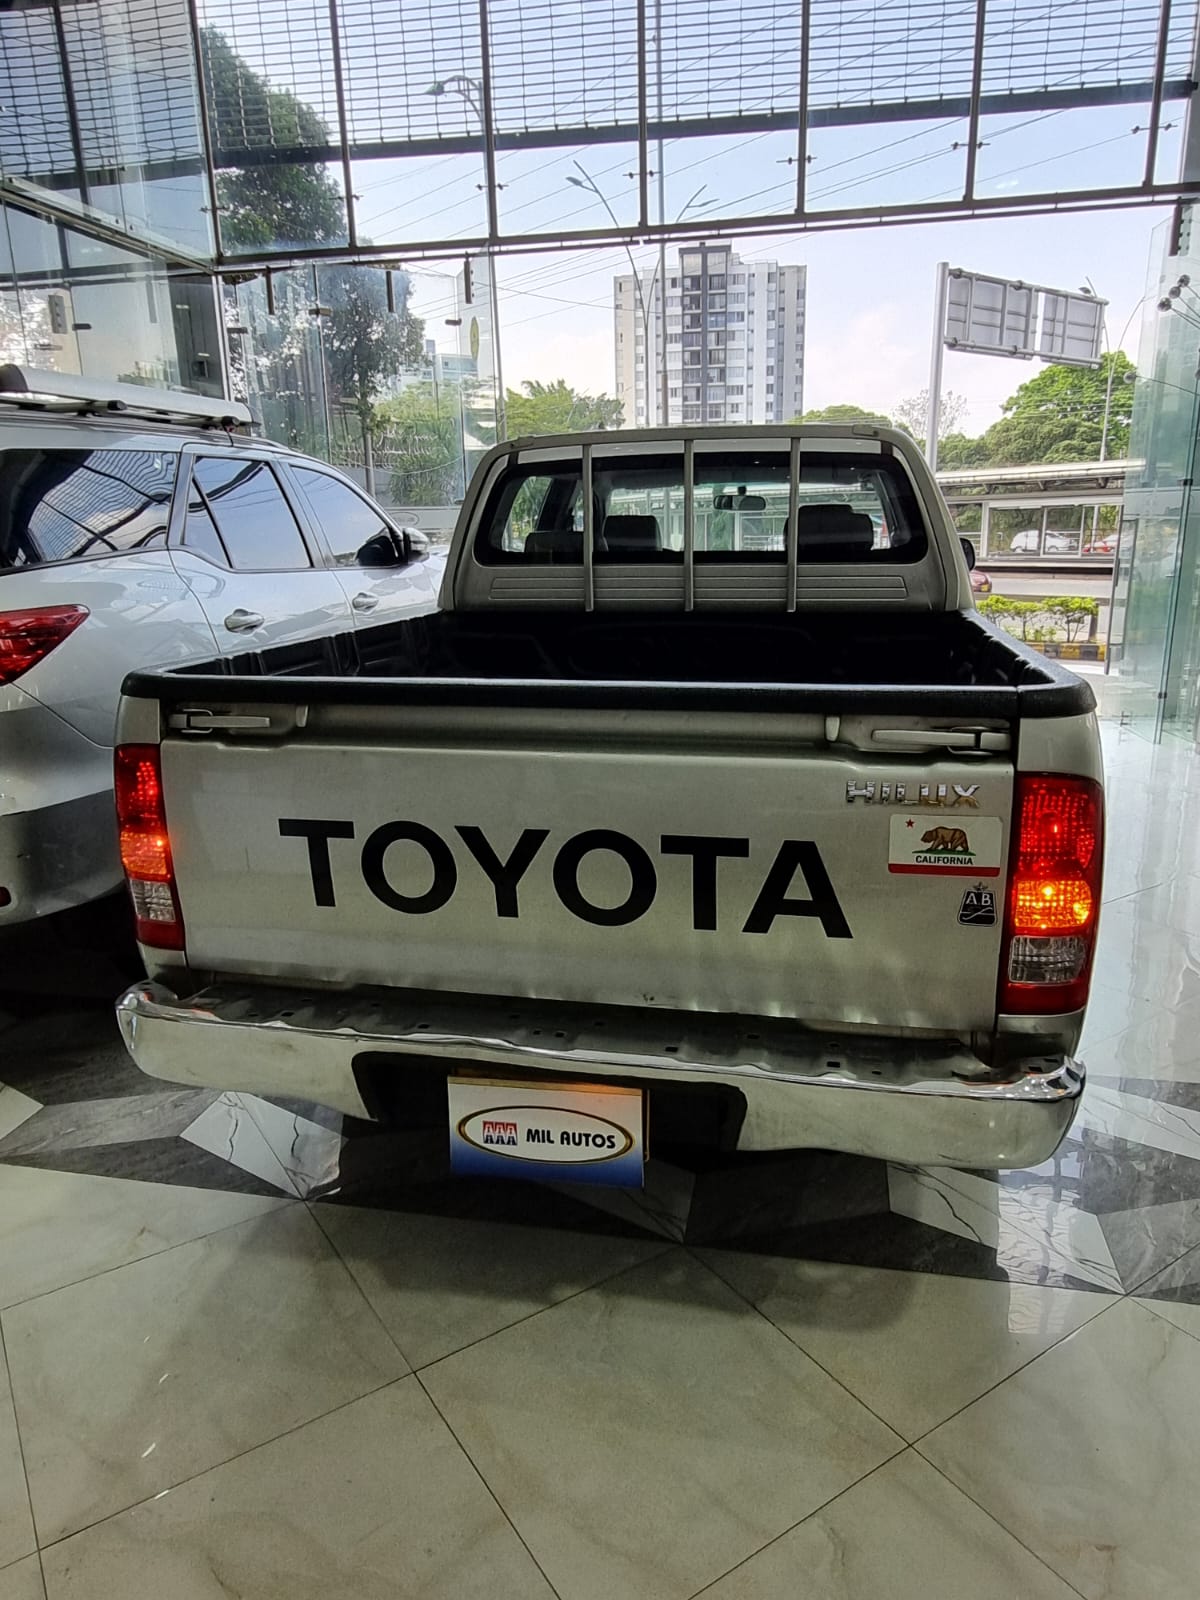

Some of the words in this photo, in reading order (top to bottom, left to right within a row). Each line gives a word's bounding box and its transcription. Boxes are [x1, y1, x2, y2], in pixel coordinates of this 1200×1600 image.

[847, 780, 981, 808] HILUX
[915, 855, 974, 865] CALIFORNIA
[278, 818, 854, 939] TOYOTA
[526, 1128, 555, 1144] MIL
[560, 1131, 616, 1149] AUTOS
